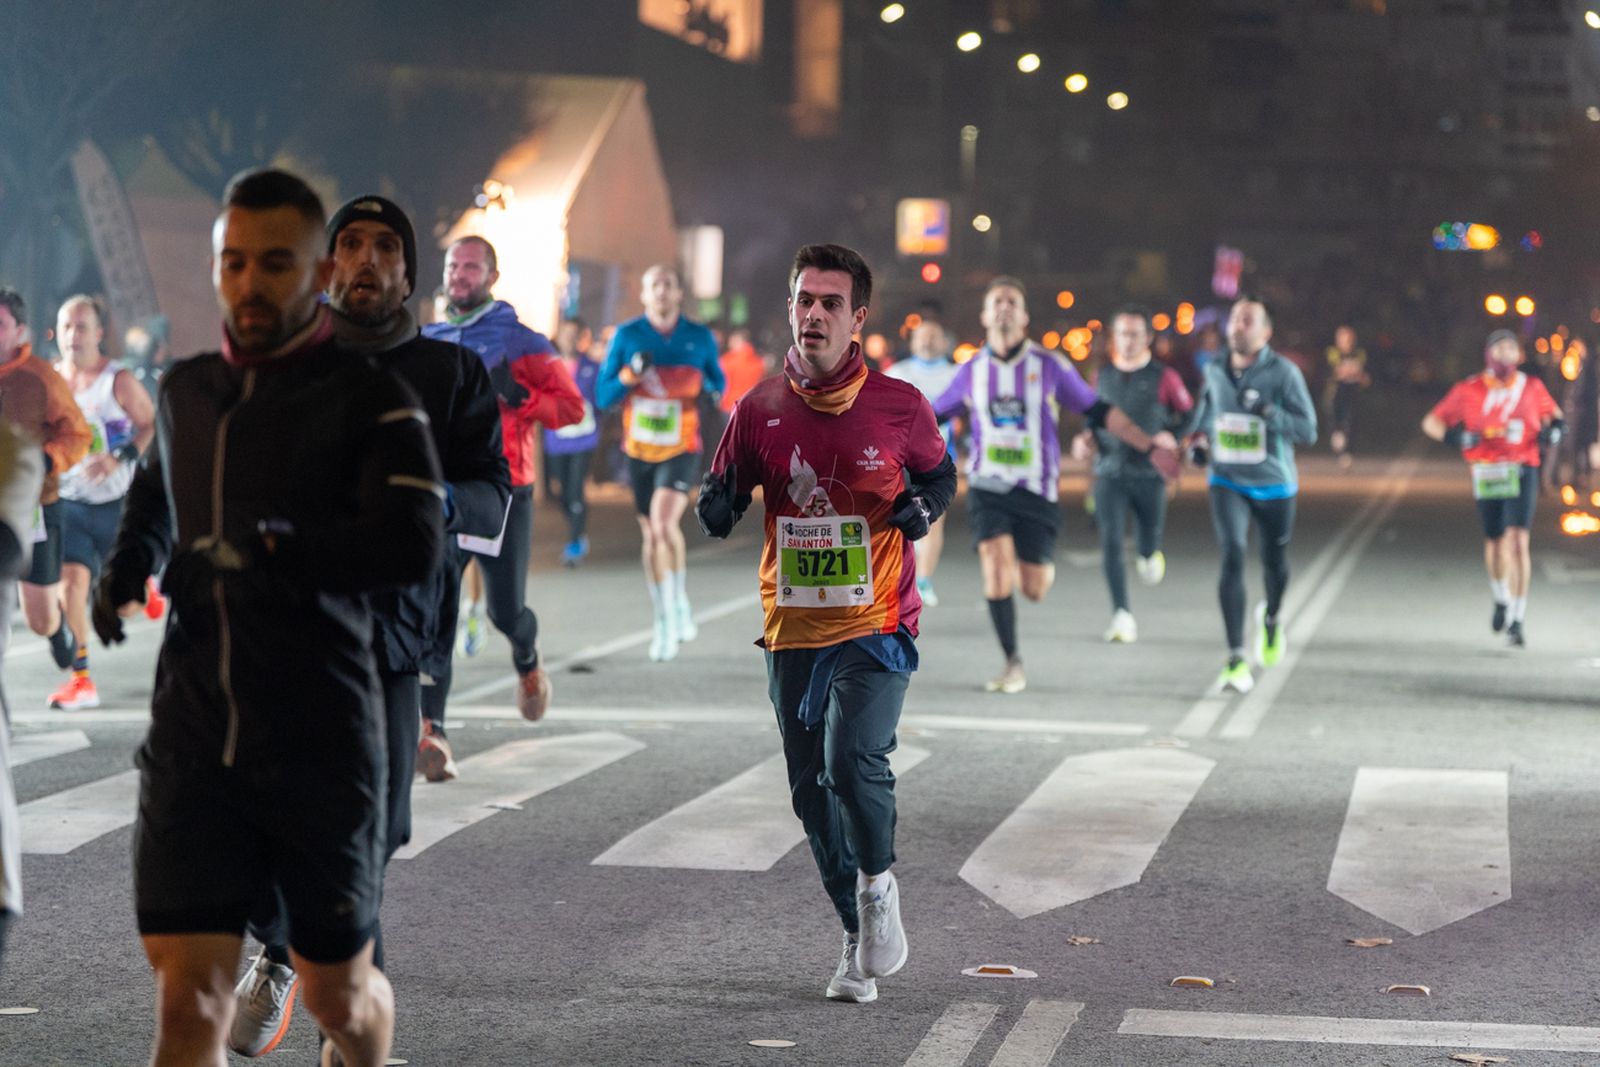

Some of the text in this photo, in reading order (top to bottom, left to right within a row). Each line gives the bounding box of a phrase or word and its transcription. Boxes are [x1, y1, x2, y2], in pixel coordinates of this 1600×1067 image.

[805, 494, 828, 517] 43
[821, 527, 832, 536] DE
[802, 536, 833, 548] ANTÓN
[797, 549, 849, 576] 5721
